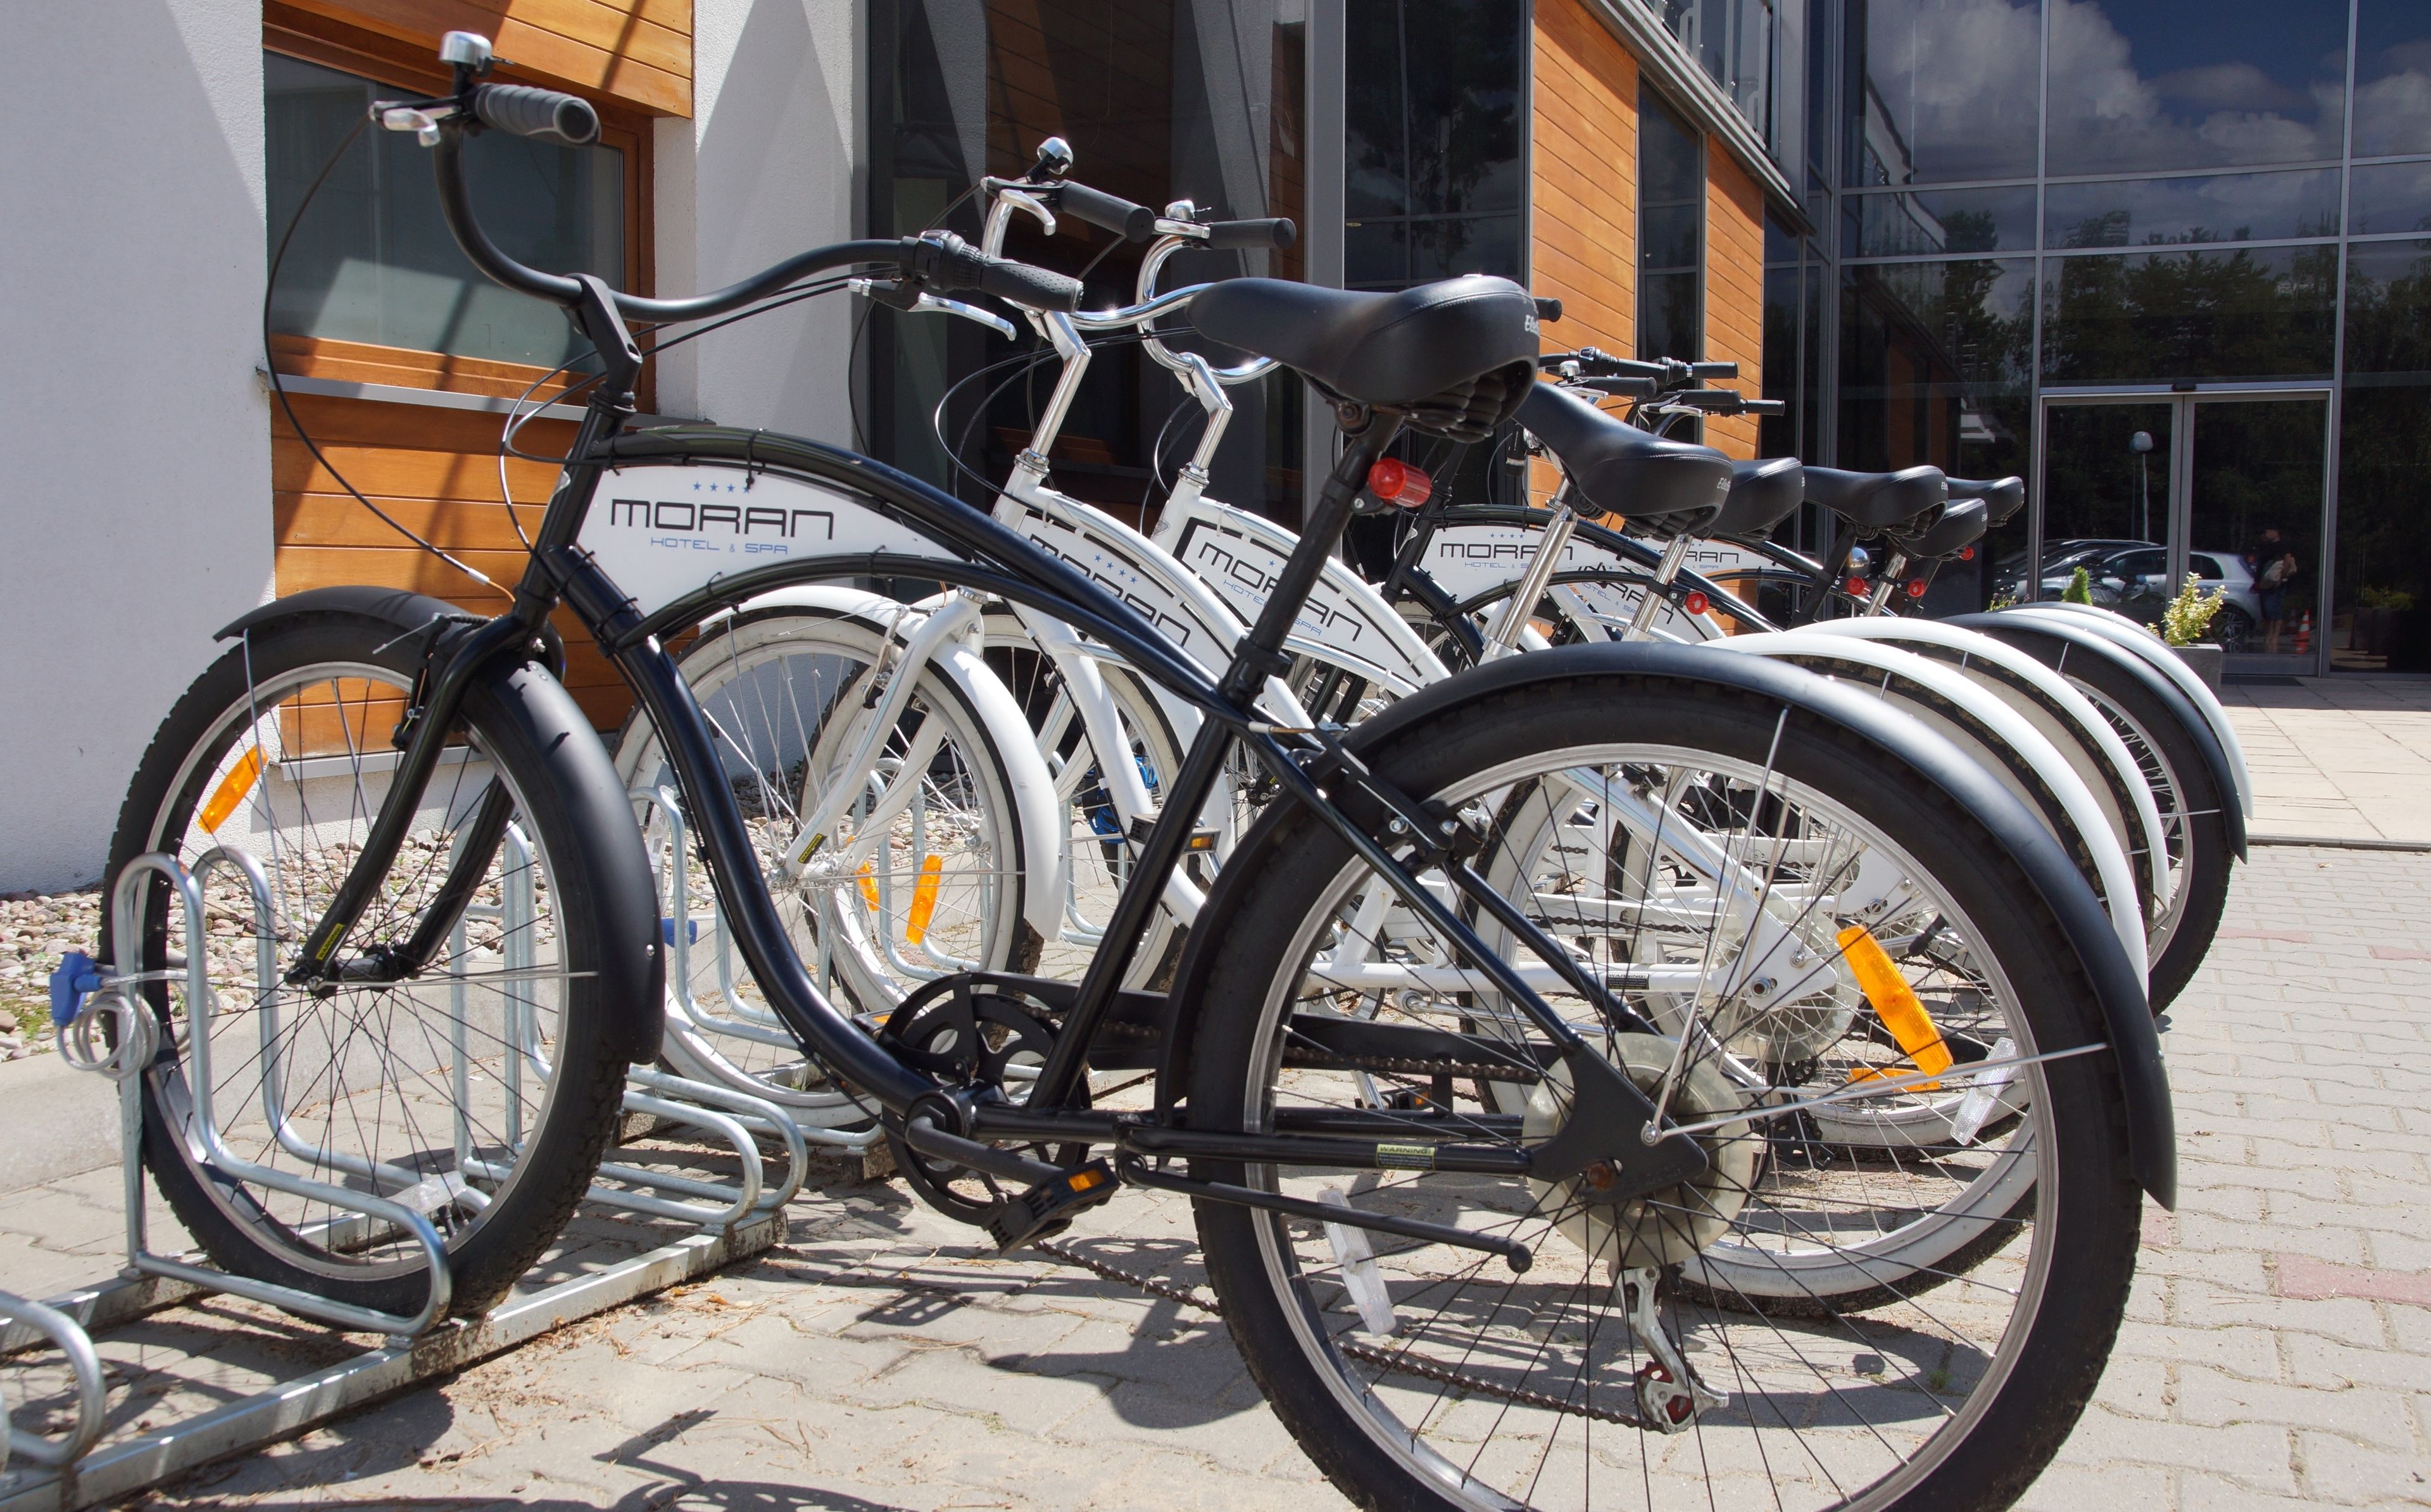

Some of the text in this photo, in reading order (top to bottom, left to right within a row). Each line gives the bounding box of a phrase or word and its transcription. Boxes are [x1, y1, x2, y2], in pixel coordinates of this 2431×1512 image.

[611, 499, 834, 540] MORAN
[651, 537, 788, 555] HOTEL & SPA
[1583, 582, 1611, 602] OTEL
[1380, 1146, 1431, 1154] WARNING!
